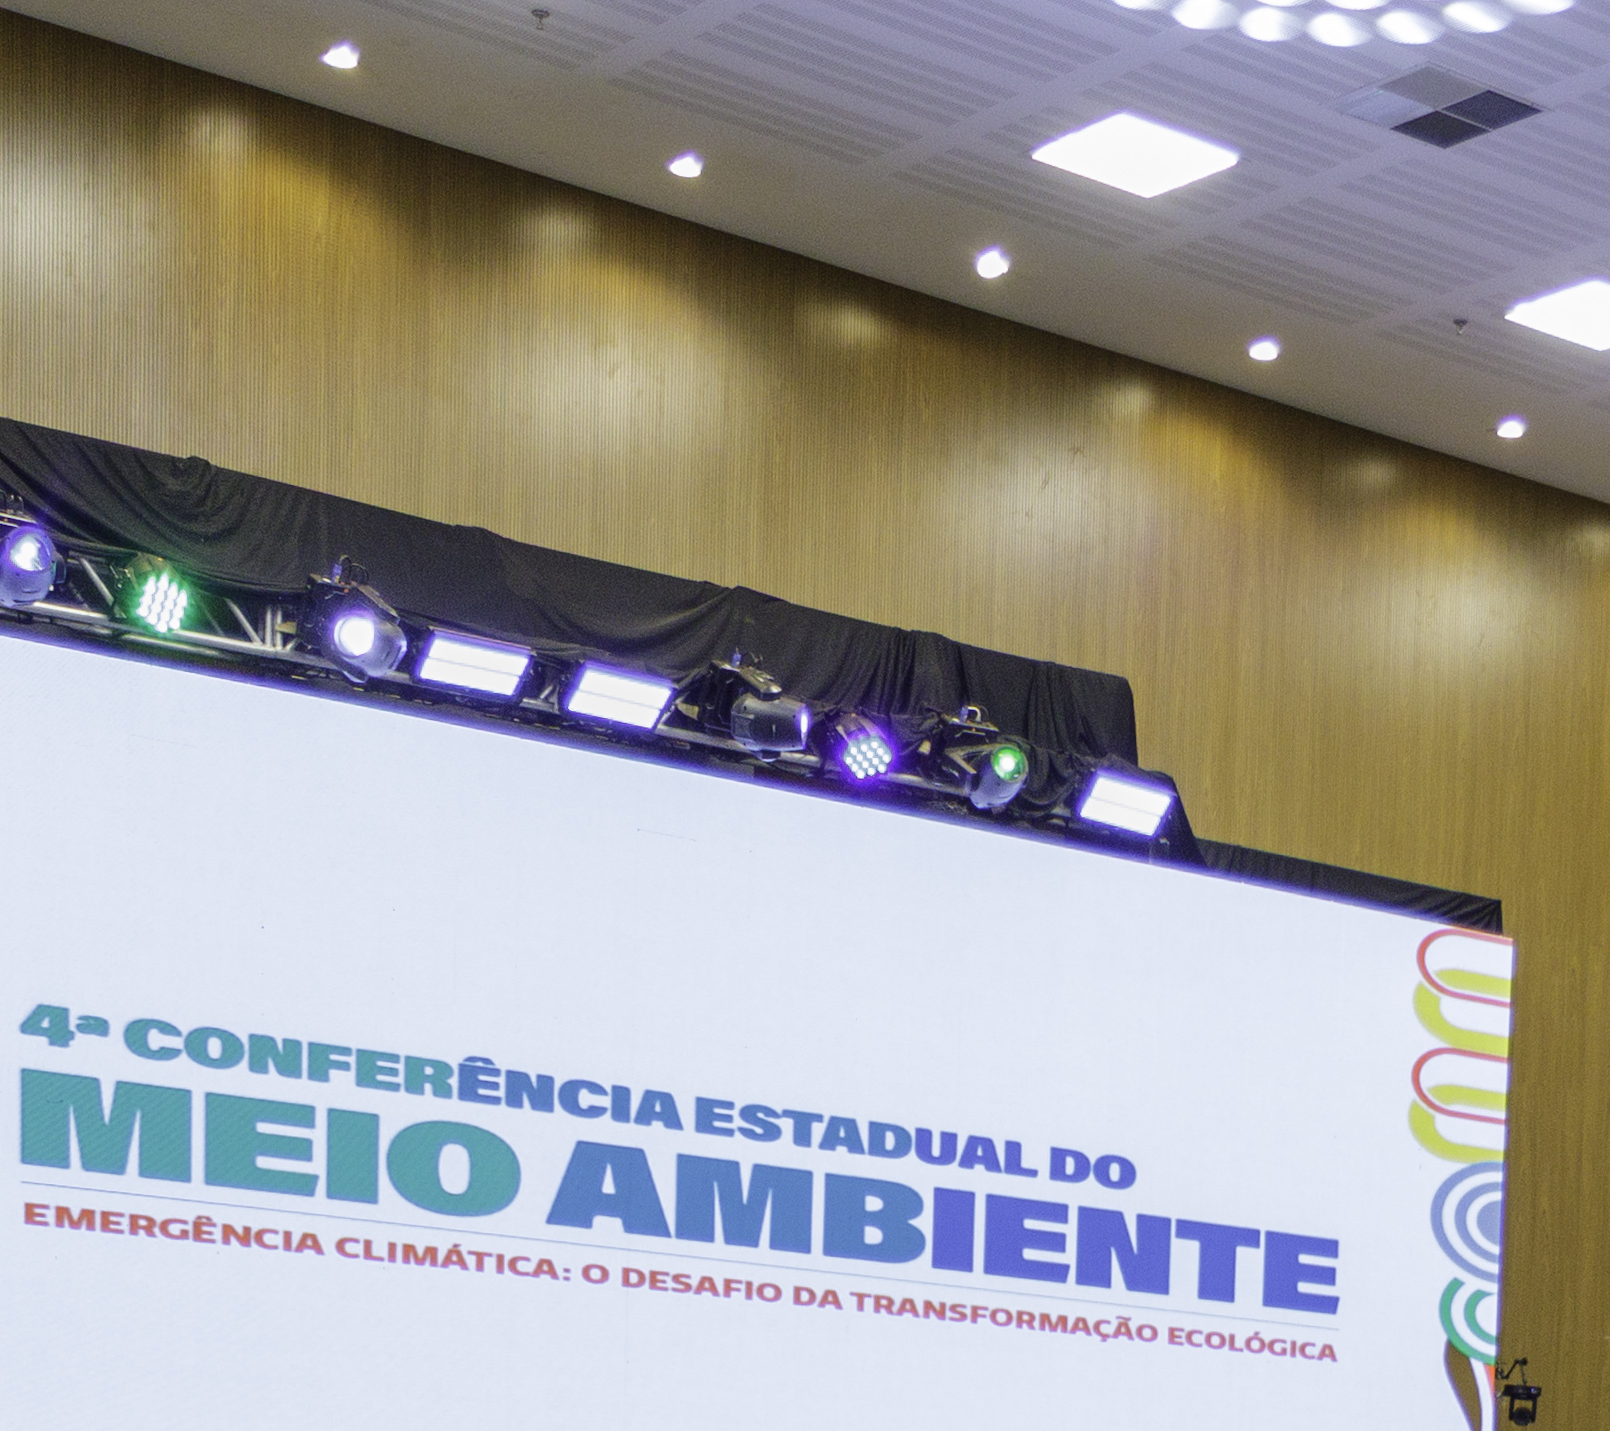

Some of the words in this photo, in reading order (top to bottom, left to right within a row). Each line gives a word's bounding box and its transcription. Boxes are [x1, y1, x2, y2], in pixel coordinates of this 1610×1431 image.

[121, 1016, 686, 1133] CONFERÊNCIA
[693, 1095, 1040, 1180] ESTADUAL
[1048, 1145, 1139, 1191] DO
[18, 1066, 523, 1219] MEIO
[543, 1138, 1342, 1317] AMBIENTE
[24, 1201, 326, 1257] EMERGÊNCIA
[336, 1236, 574, 1282] CLIMÁTICA:
[580, 1264, 610, 1286] O
[621, 1267, 782, 1304] DESAFIO
[792, 1287, 844, 1311] DA
[849, 1290, 1159, 1345] TRANSFORMAÇÃO
[1167, 1327, 1338, 1364] ECOLÓGICA
